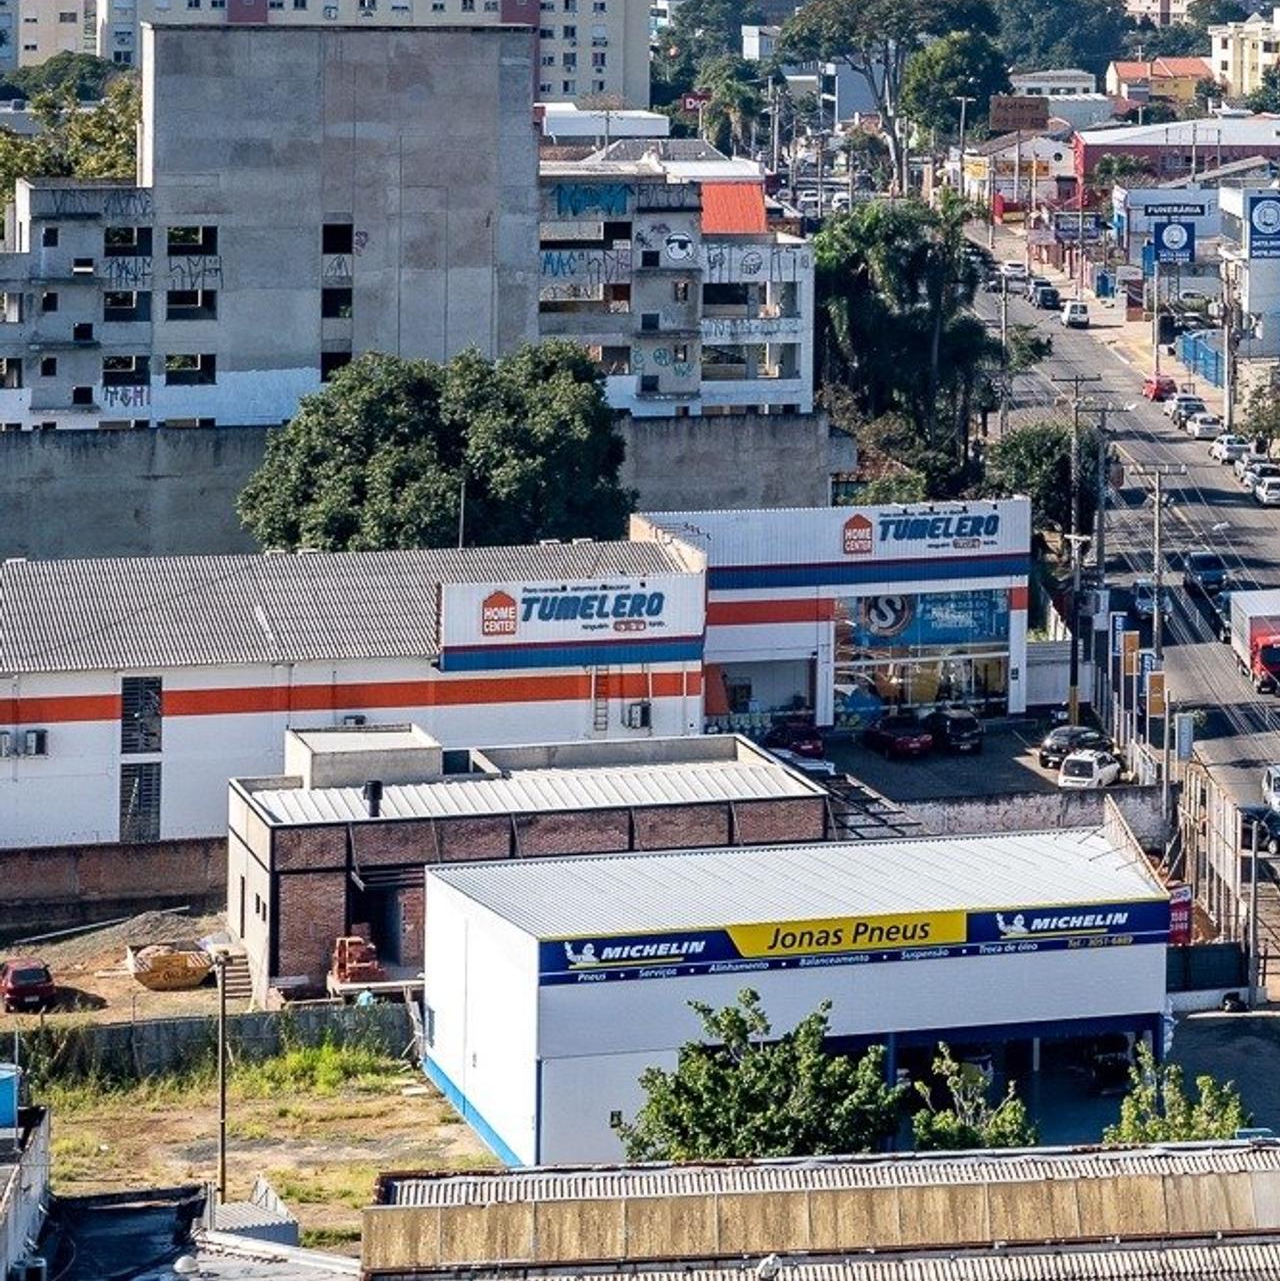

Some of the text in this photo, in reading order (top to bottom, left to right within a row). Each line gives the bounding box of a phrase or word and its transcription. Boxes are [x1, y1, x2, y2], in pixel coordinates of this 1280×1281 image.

[845, 528, 872, 540] HOME
[878, 514, 1000, 542] TUMELERO
[845, 540, 872, 551] CENTER
[483, 606, 516, 619] HOME
[521, 592, 665, 622] TUMELERO
[483, 620, 516, 632] CENTER
[1031, 912, 1129, 931] MICHELIN
[767, 921, 931, 950] Jonas Pneus
[601, 940, 706, 960] MICHELIN
[577, 972, 607, 983] Pneus
[639, 967, 678, 979] Serviços
[709, 961, 770, 974] Alinhamento
[800, 953, 870, 967] Balanceamento
[901, 947, 950, 960] Suspensão
[1005, 943, 1016, 953] de
